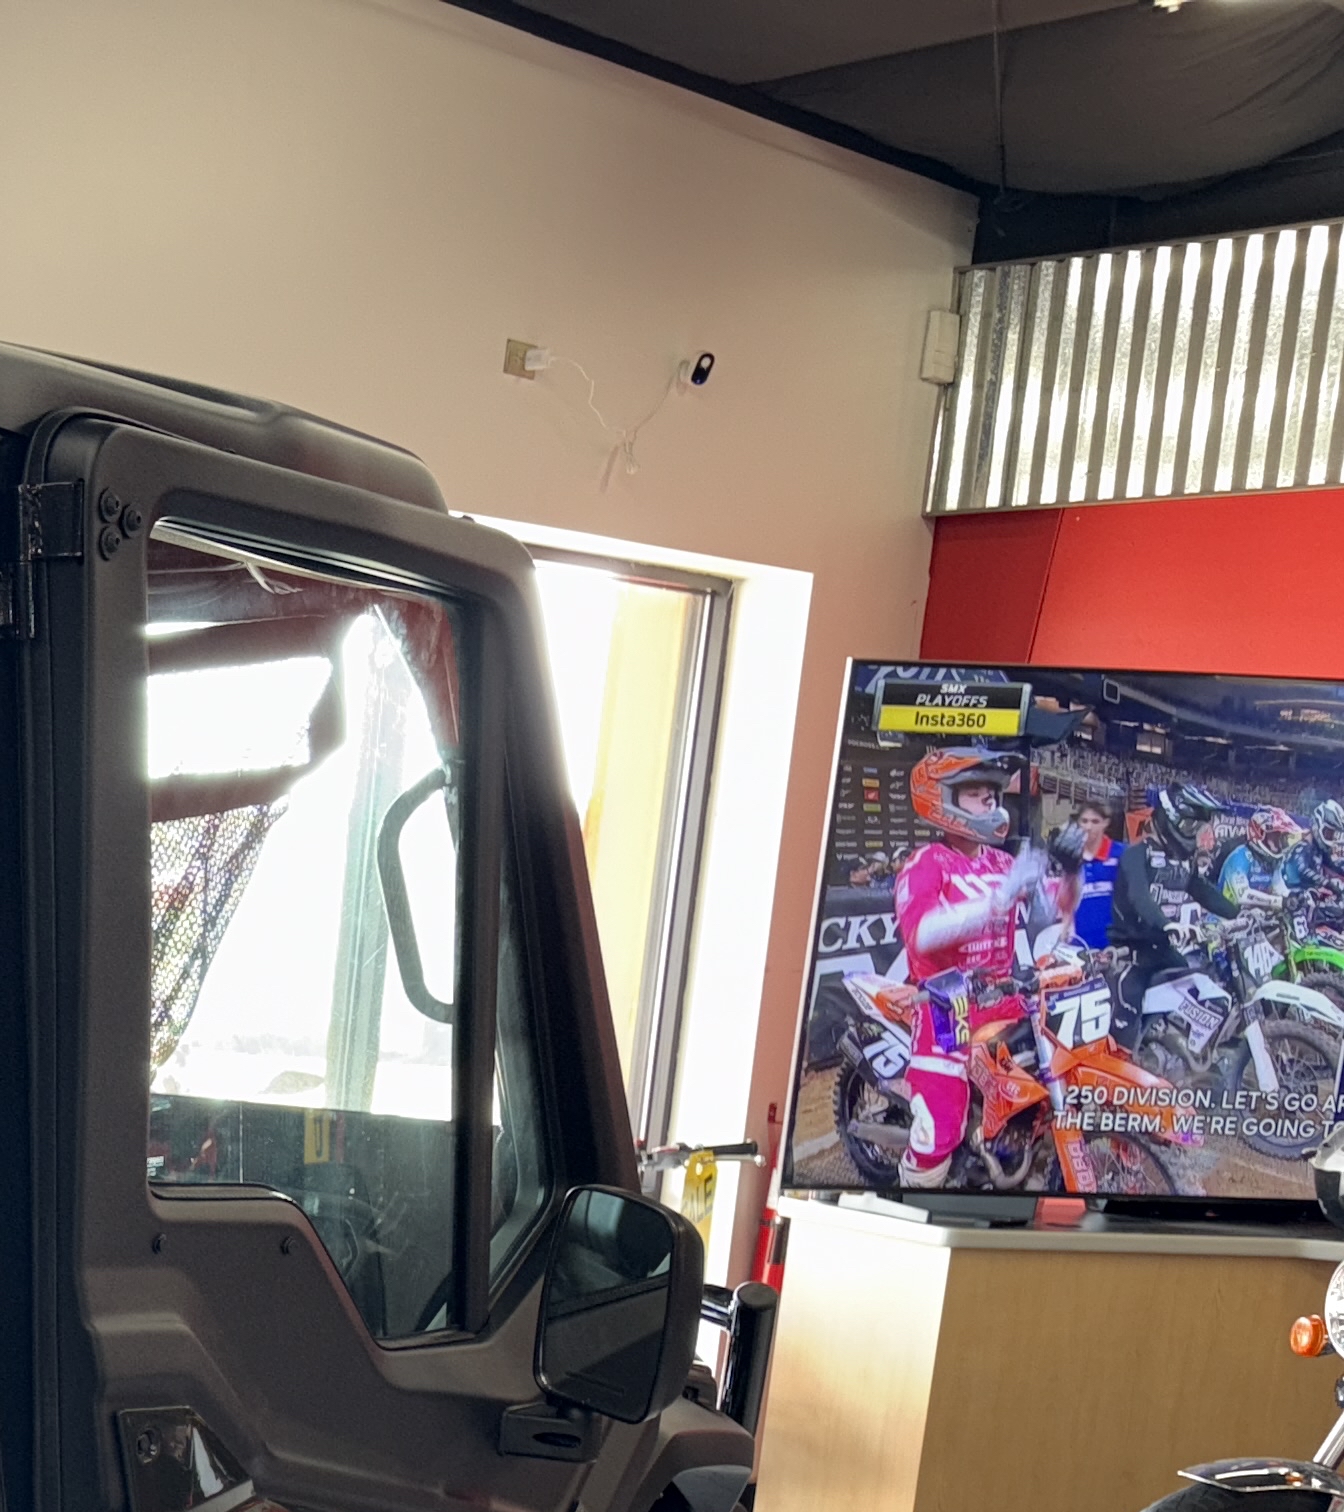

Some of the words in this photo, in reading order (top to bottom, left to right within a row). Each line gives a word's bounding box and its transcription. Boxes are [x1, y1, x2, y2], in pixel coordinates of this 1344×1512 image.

[939, 682, 968, 695] SMX
[915, 693, 989, 708] PLAYOFFS
[914, 711, 987, 729] Insta360
[1049, 987, 1112, 1050] 75
[1065, 1085, 1108, 1105] 250
[1112, 1086, 1215, 1109] DIVISION.
[1221, 1089, 1280, 1111] LET'S
[1283, 1093, 1319, 1113] GO
[1053, 1110, 1096, 1131] THE
[1099, 1112, 1166, 1133] BERM.
[1172, 1114, 1238, 1136] WE'RE
[1242, 1117, 1316, 1138] GOING
